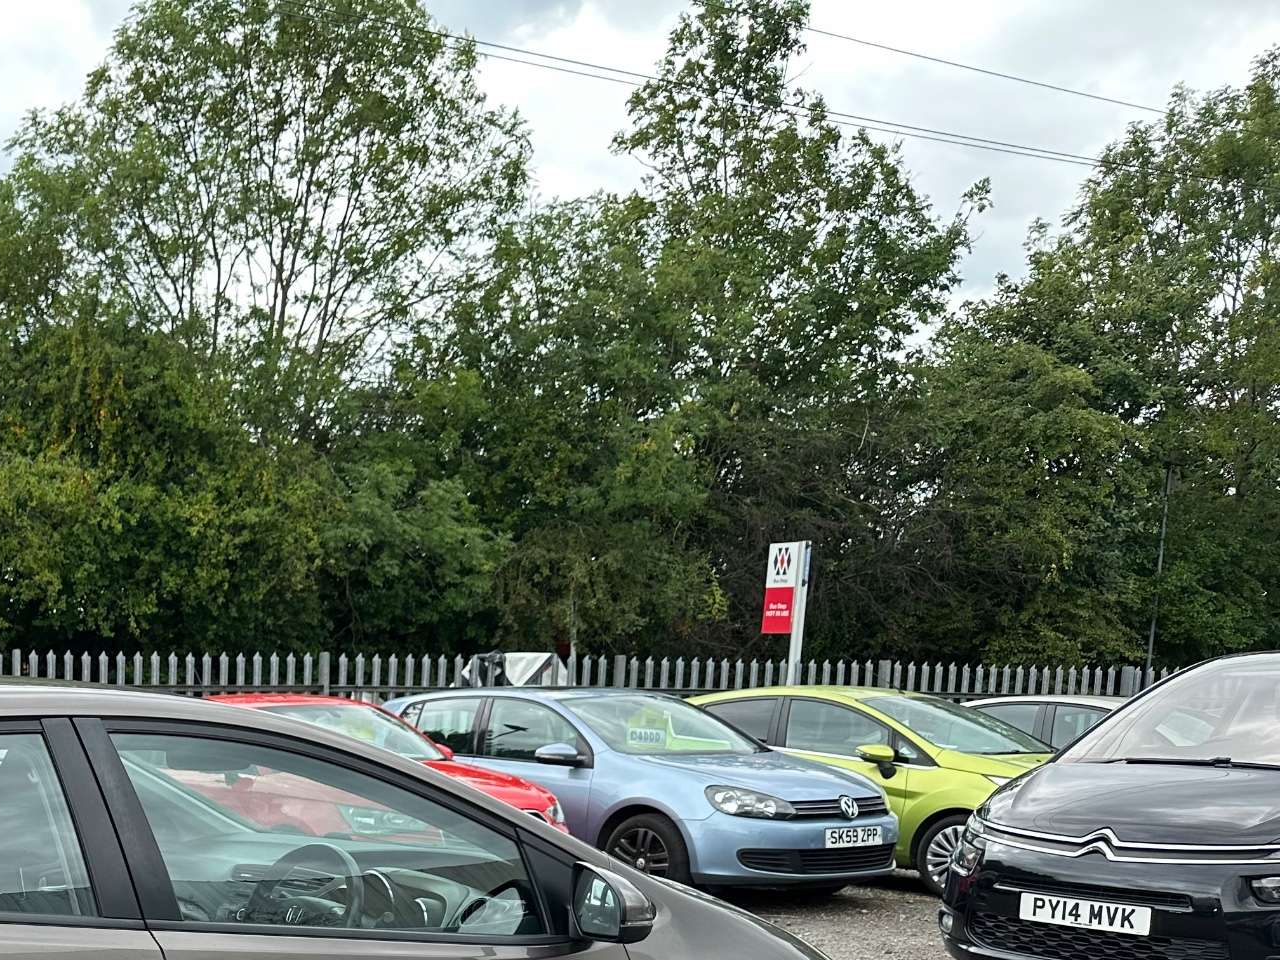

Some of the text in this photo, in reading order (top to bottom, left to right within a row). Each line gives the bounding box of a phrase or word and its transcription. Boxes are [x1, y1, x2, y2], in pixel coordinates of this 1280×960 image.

[830, 827, 878, 845] SK59 ZPP
[1032, 896, 1136, 929] PY14 MVK
